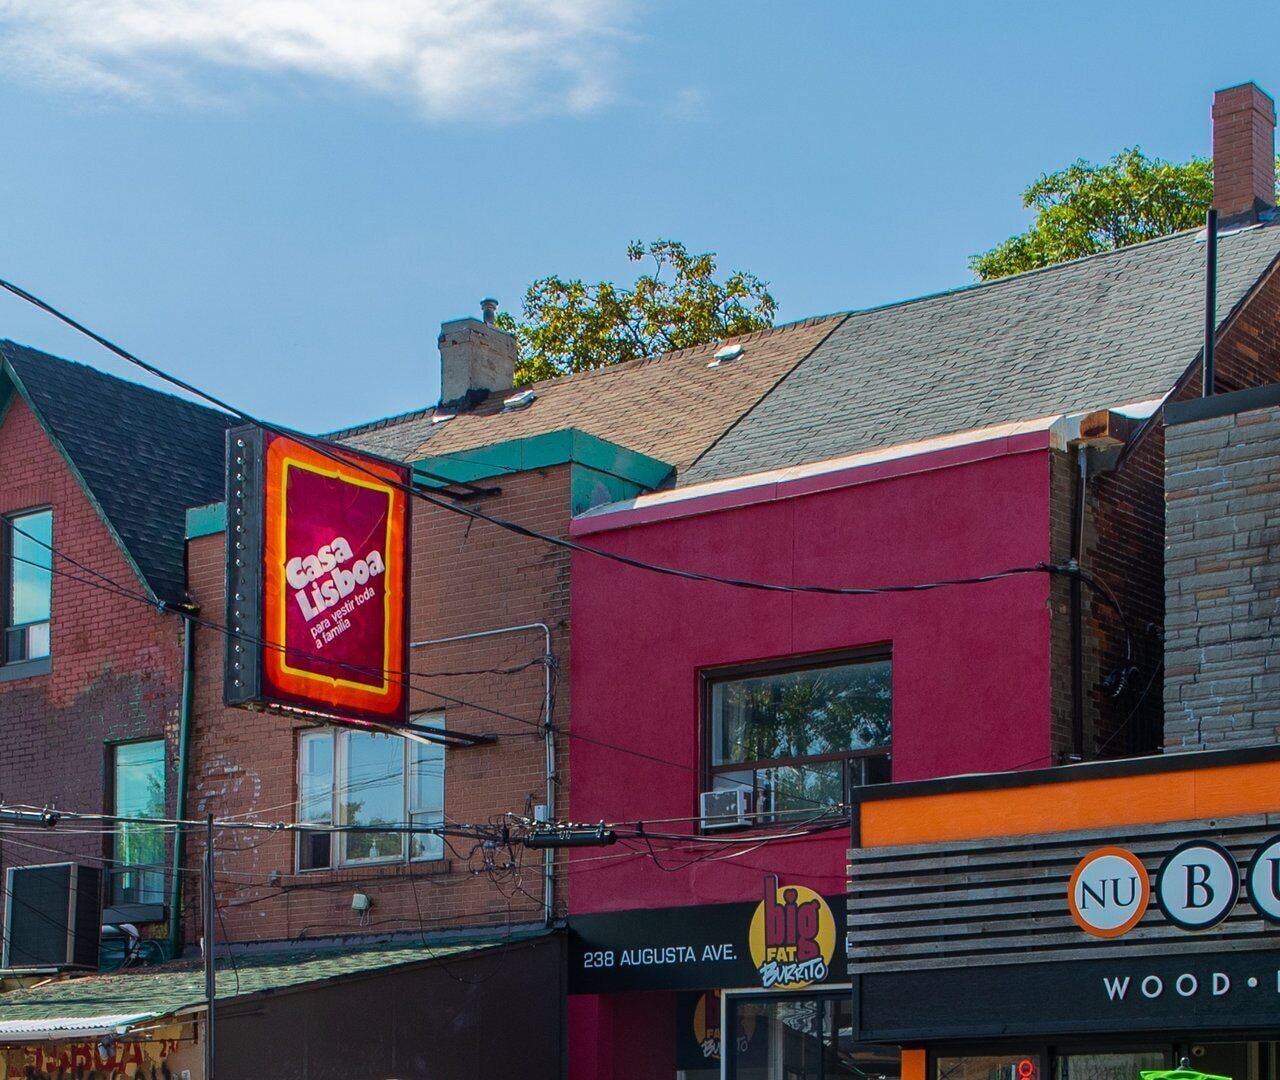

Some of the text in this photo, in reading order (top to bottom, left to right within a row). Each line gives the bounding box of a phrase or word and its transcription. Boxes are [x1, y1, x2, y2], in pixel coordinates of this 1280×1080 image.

[286, 537, 353, 589] Casa
[295, 550, 385, 621] Lisboa
[311, 587, 376, 640] para vestir toda
[316, 638, 324, 649] a
[1080, 876, 1136, 911] NU
[764, 874, 821, 961] big
[583, 944, 737, 969] 238 AUGUSTA AVE.
[767, 947, 797, 963] FAT
[760, 957, 828, 988] BURRITO
[1104, 972, 1230, 1000] WOOD
